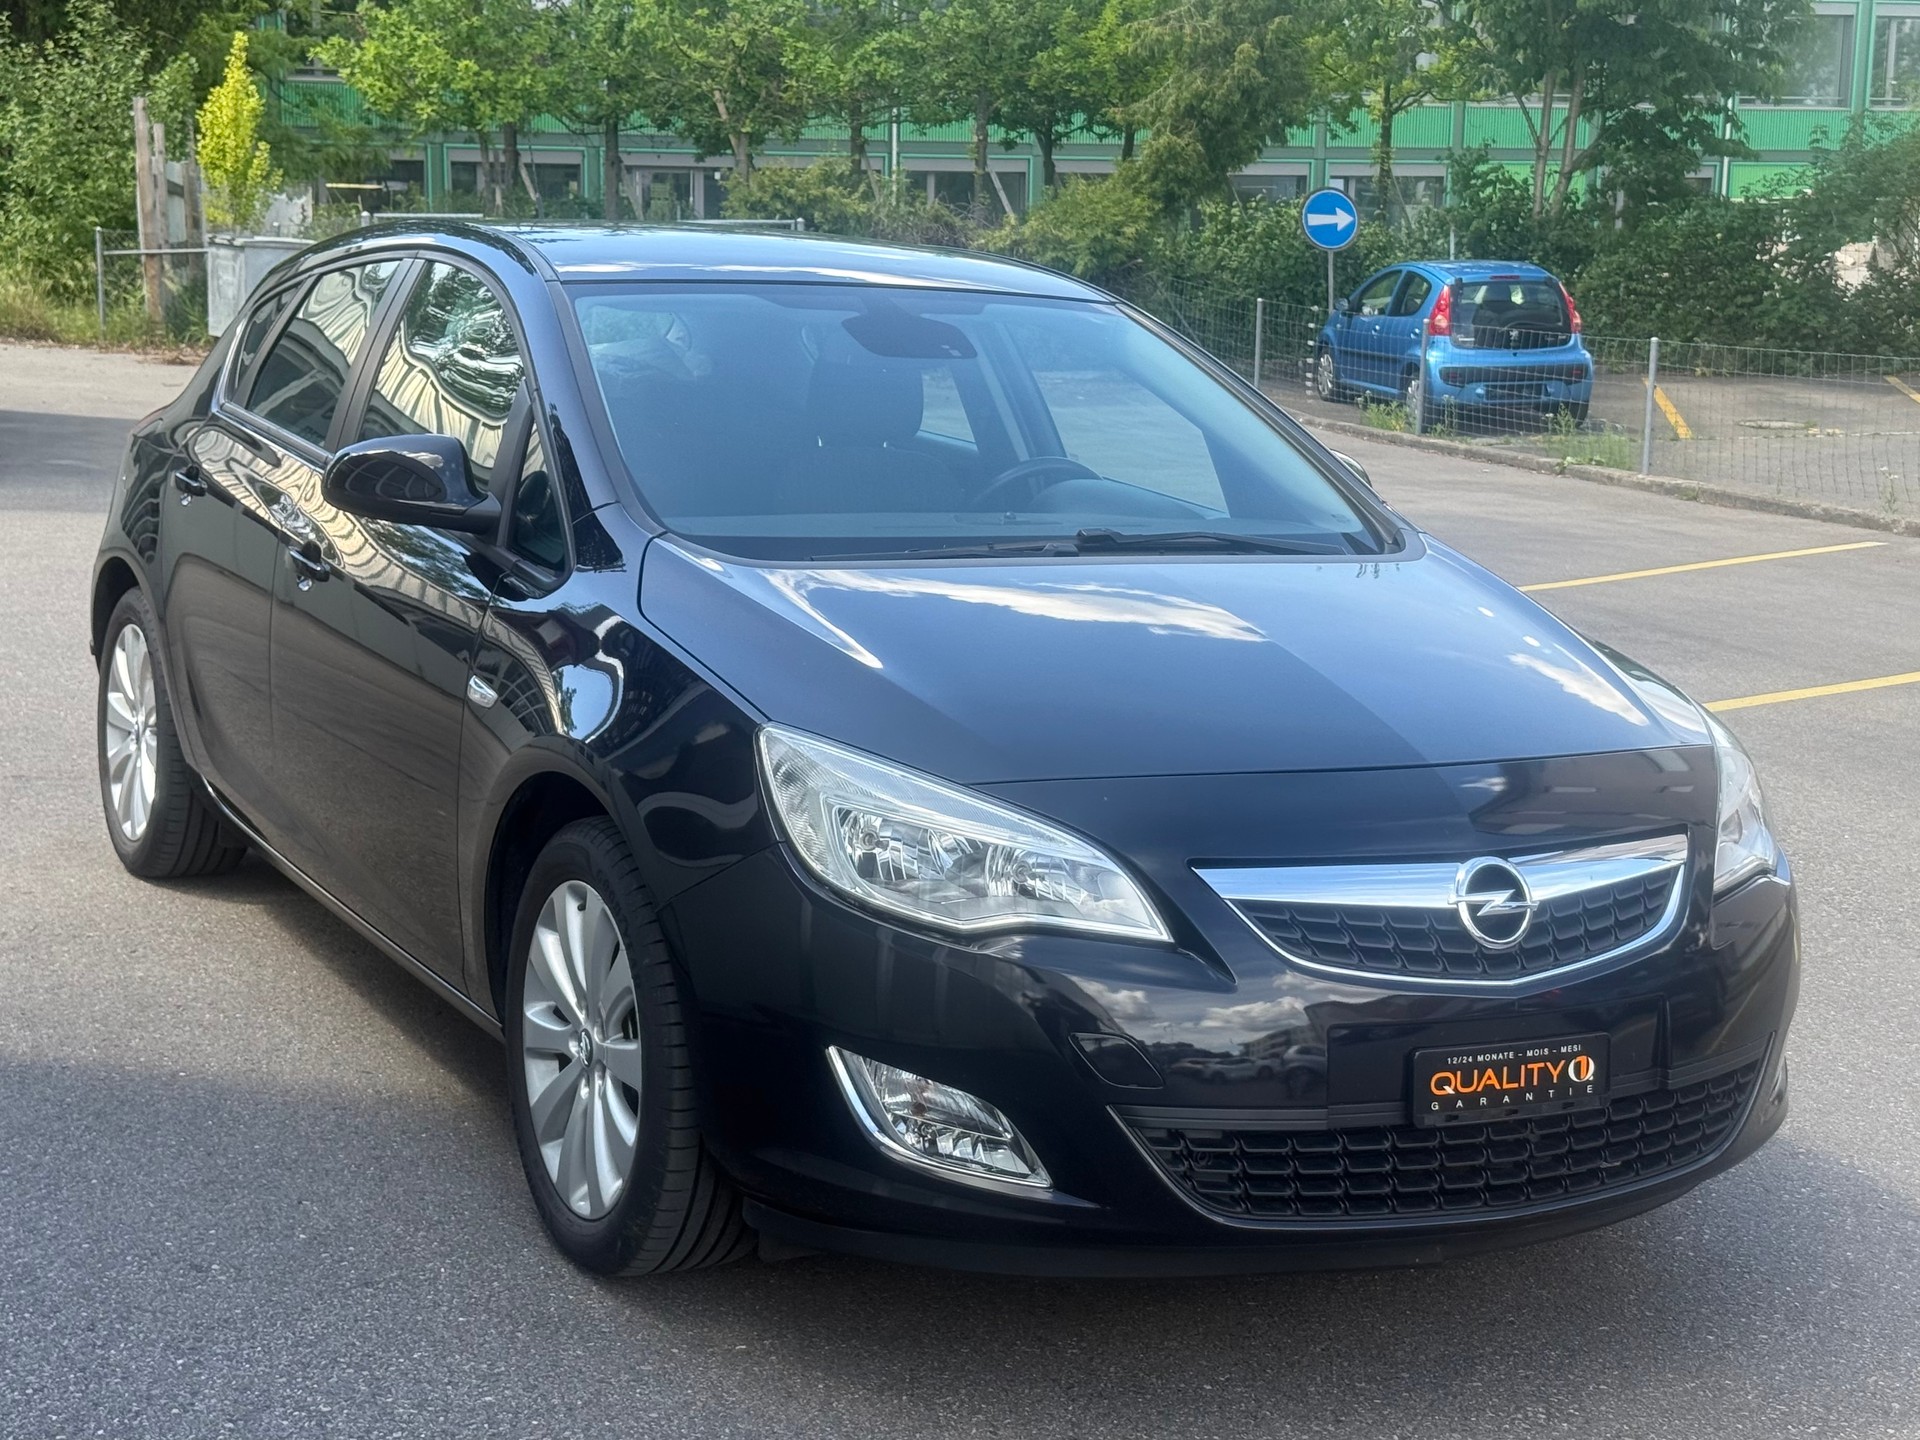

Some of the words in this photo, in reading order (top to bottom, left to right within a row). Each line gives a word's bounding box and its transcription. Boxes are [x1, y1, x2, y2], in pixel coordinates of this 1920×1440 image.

[1447, 1056, 1473, 1065] 12/24
[1477, 1051, 1514, 1062] MONATE
[1526, 1048, 1549, 1057] MOIS
[1560, 1044, 1581, 1053] MESI
